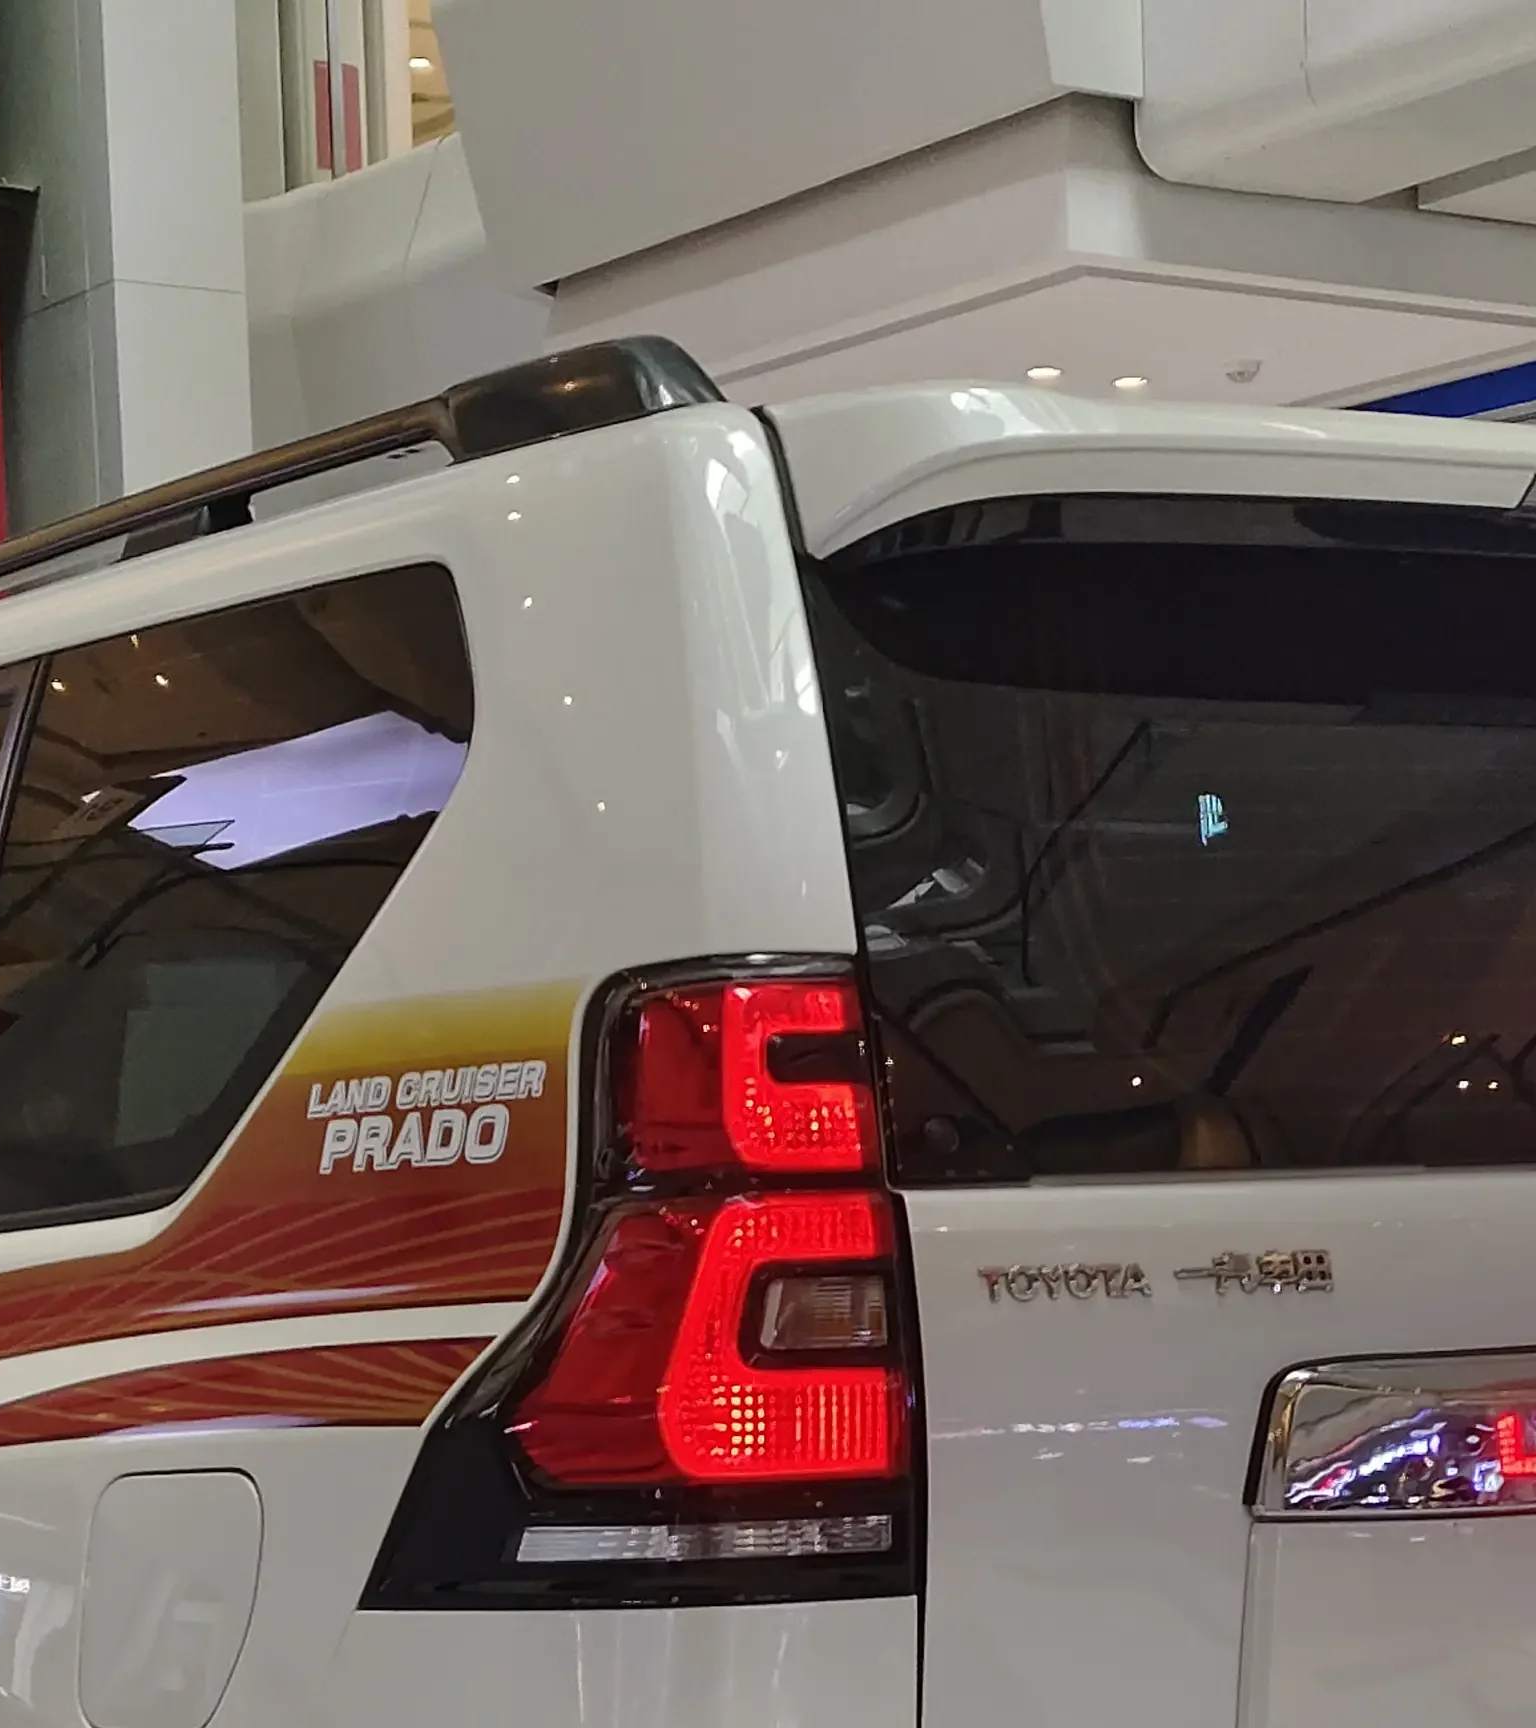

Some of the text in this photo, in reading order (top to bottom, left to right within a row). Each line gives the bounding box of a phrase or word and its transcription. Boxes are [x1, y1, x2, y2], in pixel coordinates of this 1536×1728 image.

[308, 1060, 547, 1119] LAND CRUISER
[318, 1104, 510, 1174] PRADO
[977, 1262, 1154, 1303] TOYOTA
